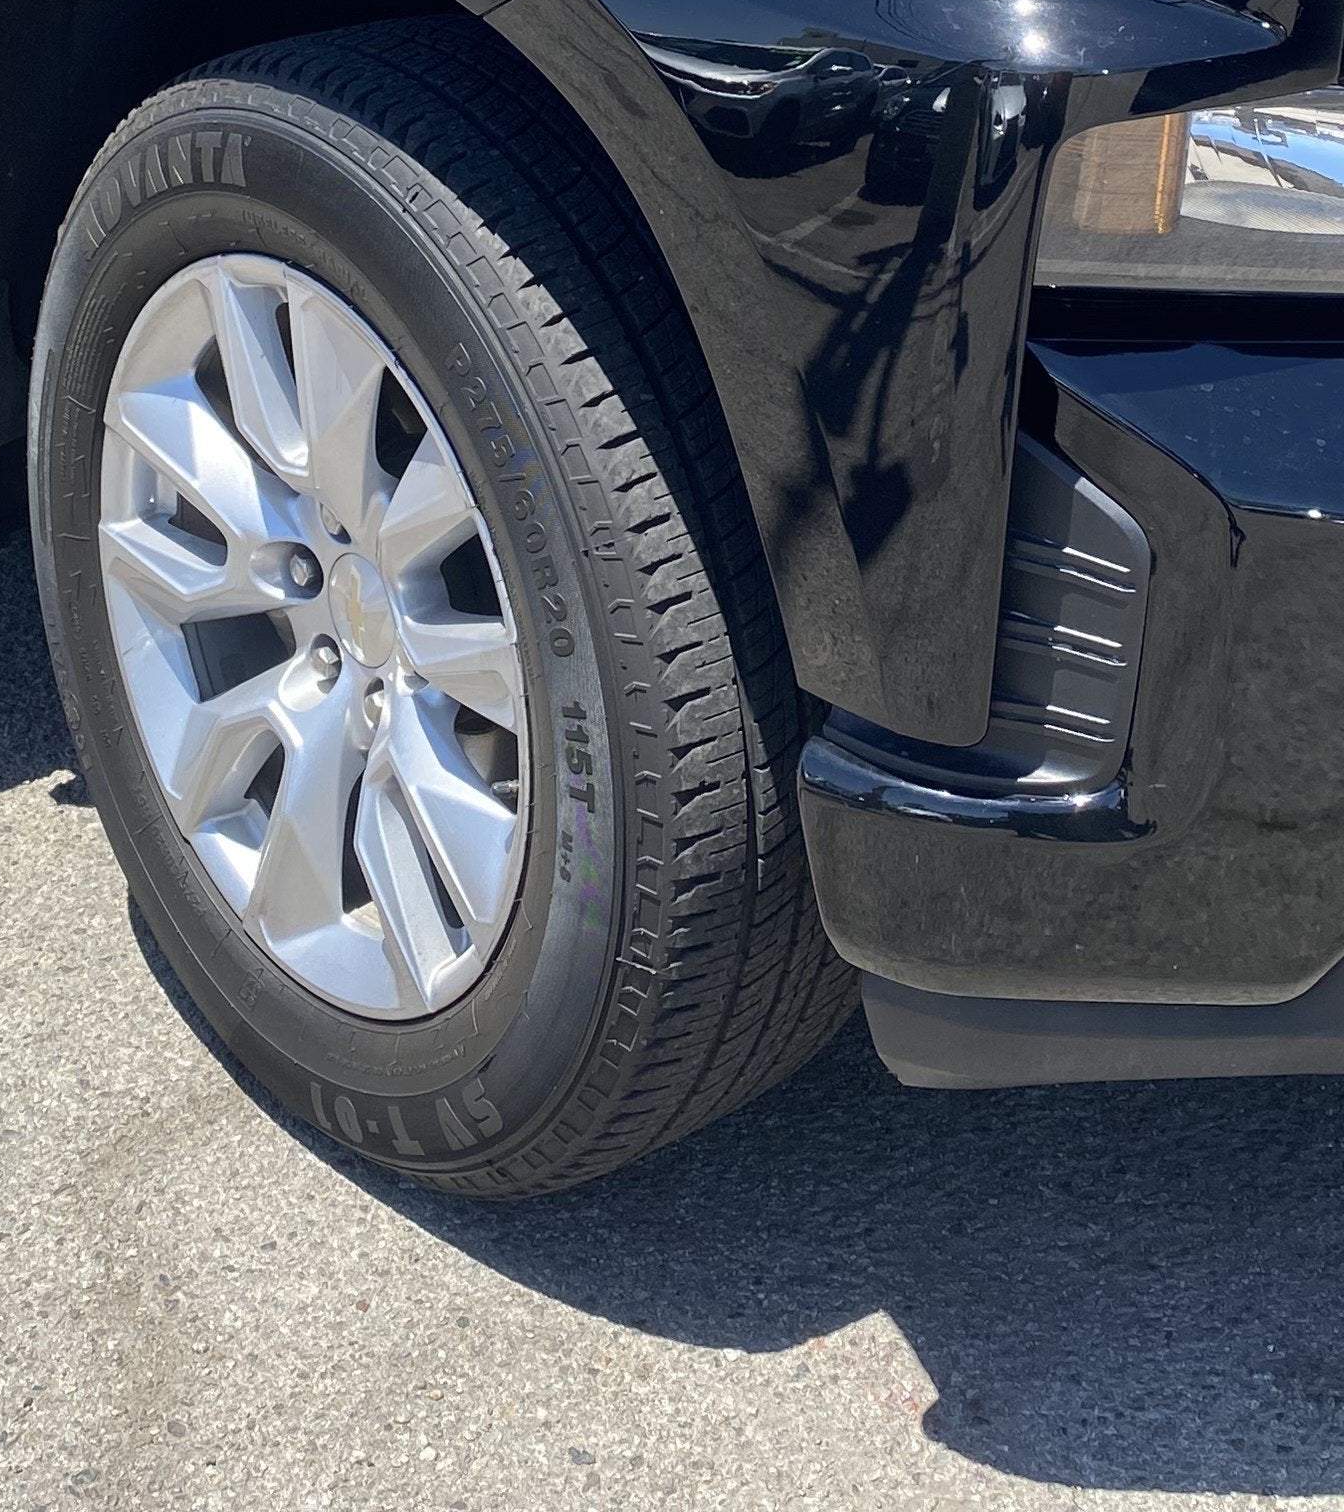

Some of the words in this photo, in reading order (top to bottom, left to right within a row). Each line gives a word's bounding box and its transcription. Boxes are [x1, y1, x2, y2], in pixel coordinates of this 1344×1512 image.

[78, 131, 248, 260] ADVANTA
[443, 340, 577, 659] P275/60R20
[561, 700, 596, 815] 115T
